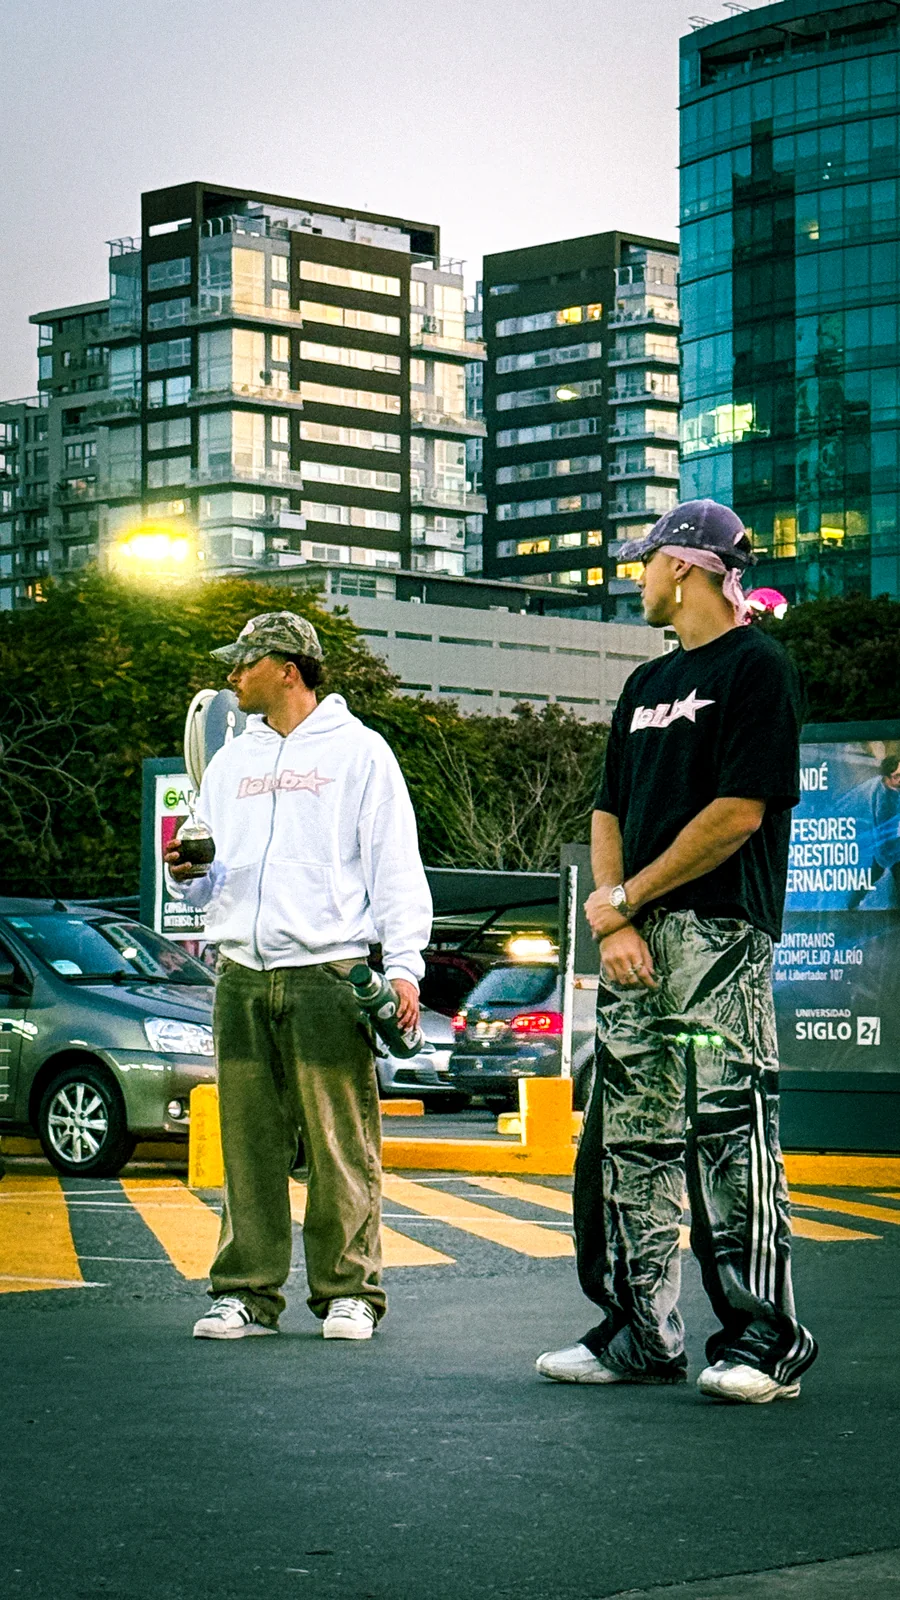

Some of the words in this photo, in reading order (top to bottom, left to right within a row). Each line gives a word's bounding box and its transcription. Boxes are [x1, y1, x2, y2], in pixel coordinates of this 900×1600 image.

[799, 762, 828, 791] NDÉ
[791, 817, 856, 842] FESORES
[786, 867, 876, 893] ERNACIONAL
[774, 932, 835, 948] ONTRANOS
[779, 949, 831, 966] COMPLEJO
[795, 1008, 852, 1018] UNIVERSIDAD
[795, 1021, 852, 1040] SIGLO
[860, 1020, 878, 1045] 21
